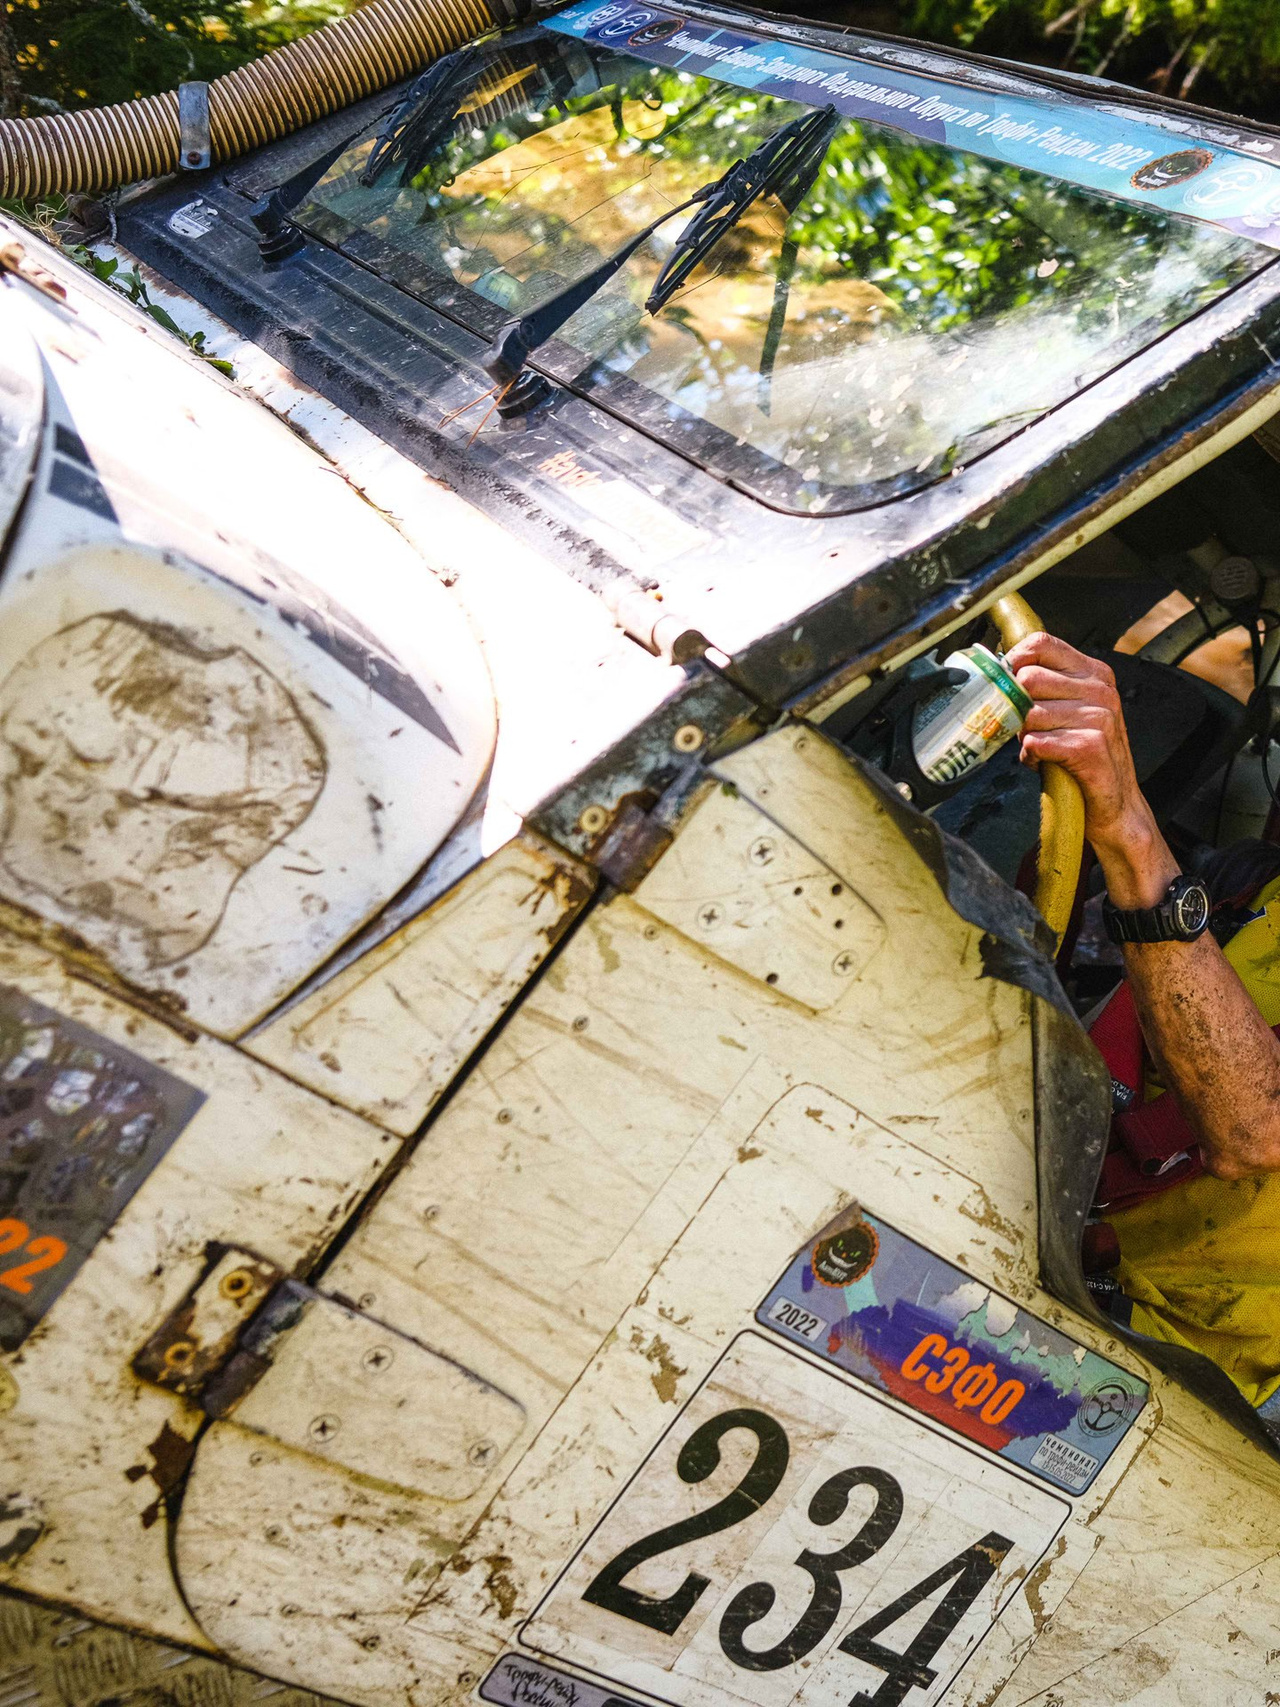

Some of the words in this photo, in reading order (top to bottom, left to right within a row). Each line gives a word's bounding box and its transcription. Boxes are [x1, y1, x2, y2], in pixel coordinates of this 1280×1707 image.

[664, 31, 721, 63] Чемпионат
[722, 45, 828, 85] Северо-Западного
[818, 71, 920, 110] Федерального
[910, 95, 964, 123] Округа
[959, 112, 990, 128] по
[976, 112, 1102, 163] Трофи-Рейдам
[1098, 142, 1154, 171] 2022
[774, 1302, 820, 1338] 2022
[900, 1332, 1026, 1427] СЗФО
[1045, 1437, 1097, 1471] чемпионат
[581, 1407, 1016, 1707] 234
